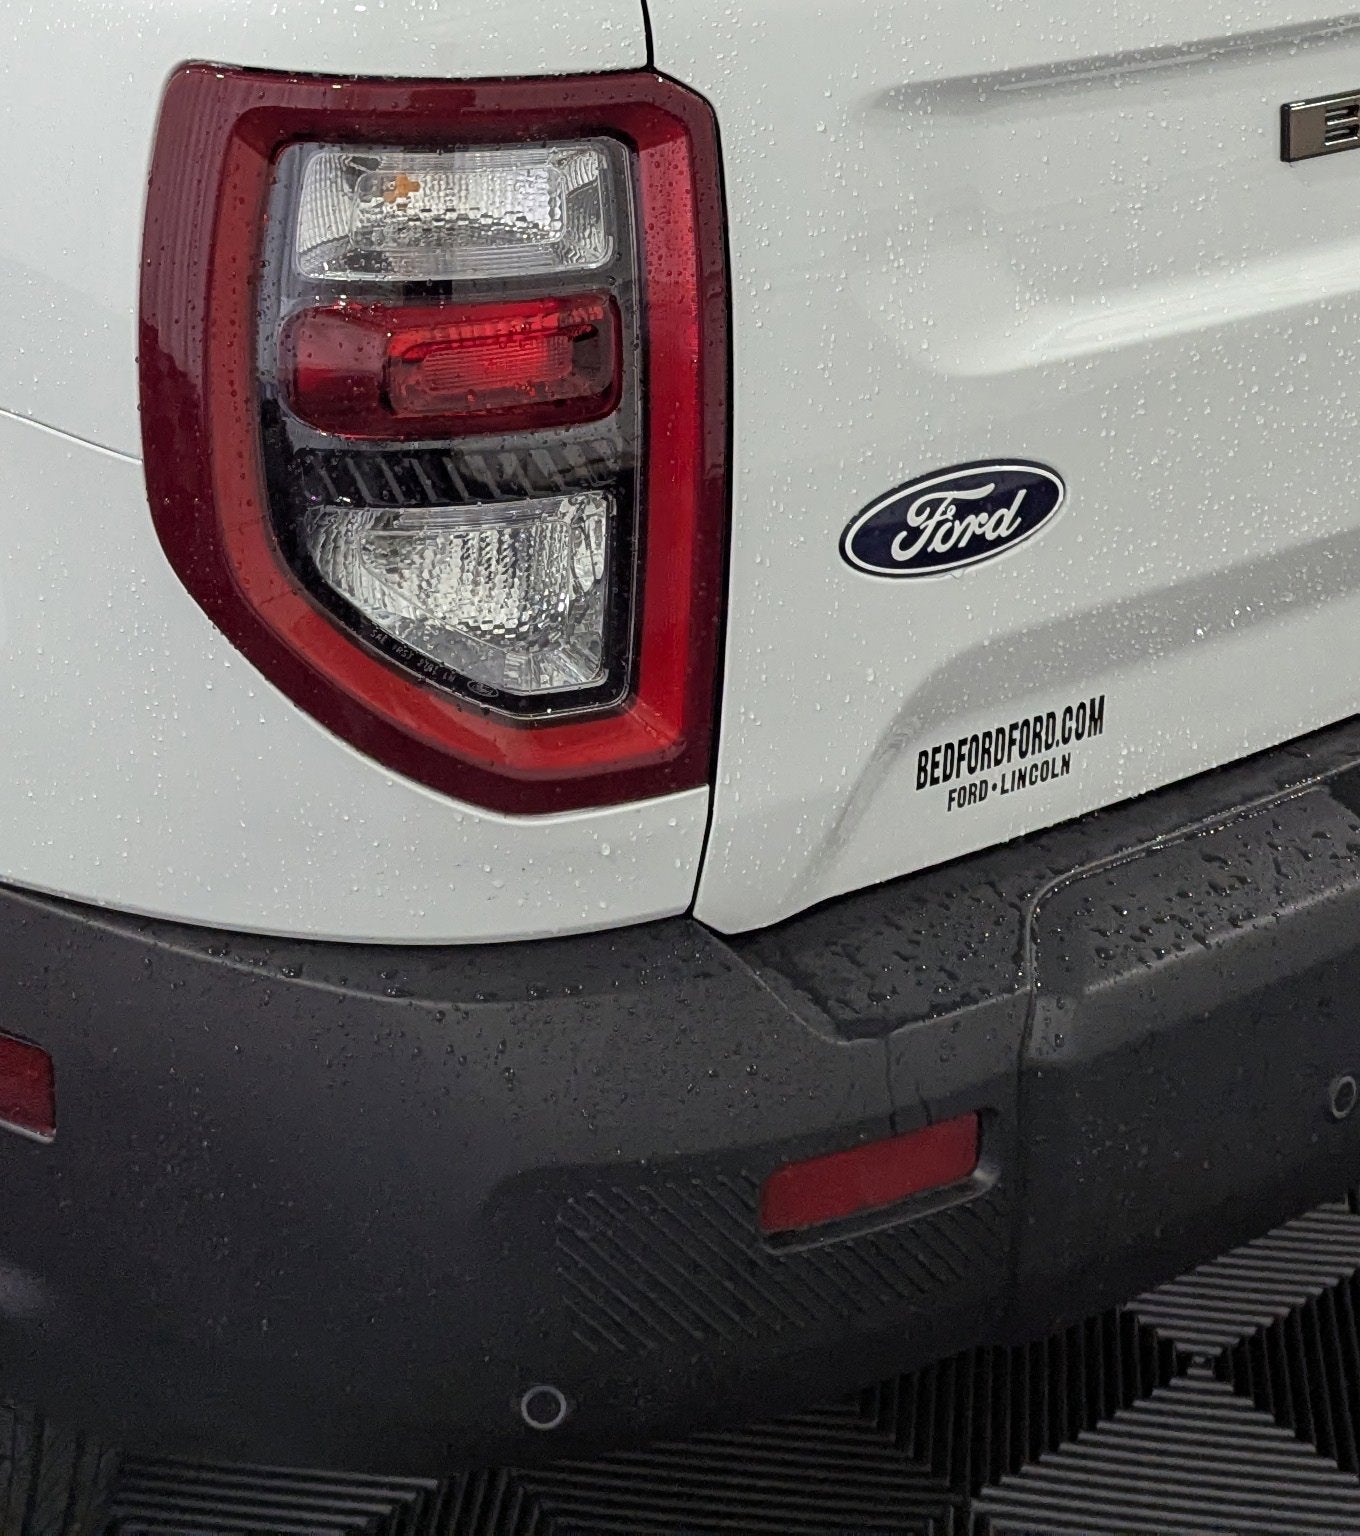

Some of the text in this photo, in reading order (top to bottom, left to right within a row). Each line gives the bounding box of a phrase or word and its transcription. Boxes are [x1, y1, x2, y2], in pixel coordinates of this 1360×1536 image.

[891, 483, 1027, 561] Ford
[915, 695, 1106, 791] BEDFORDFORD.COM
[947, 753, 1071, 812] FORD LINCOLN
